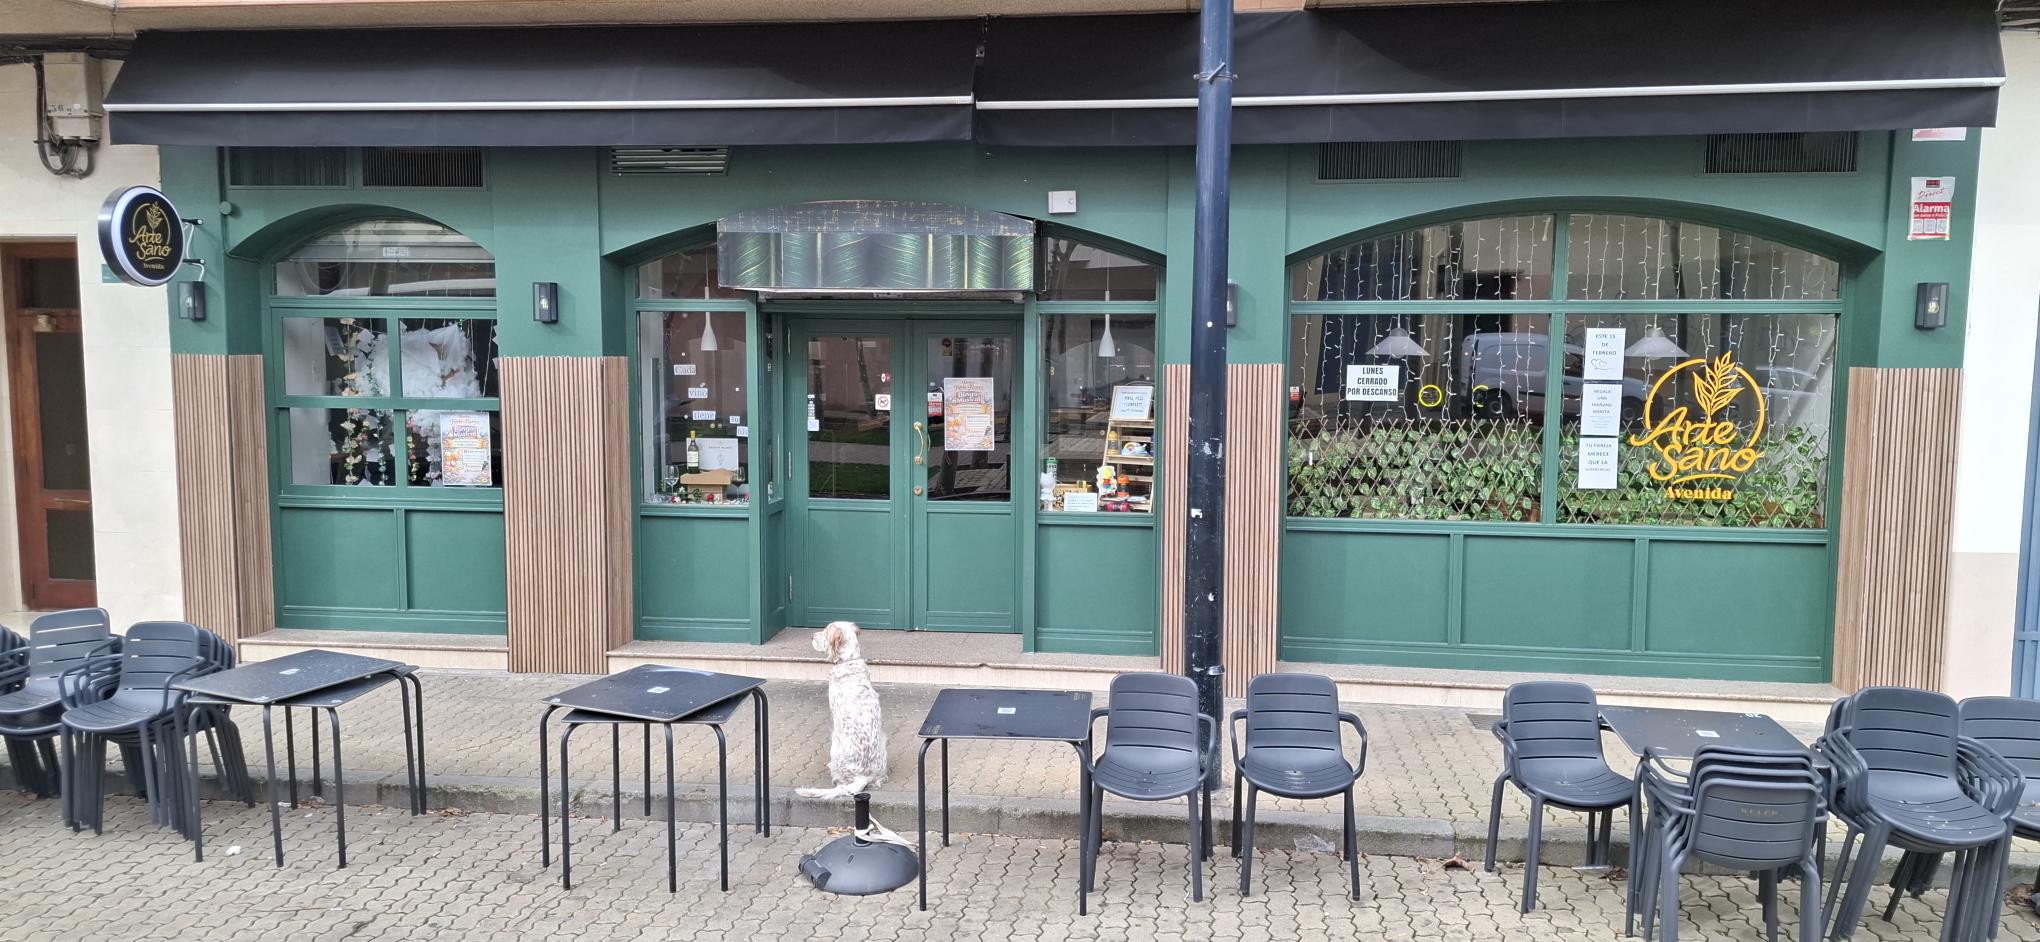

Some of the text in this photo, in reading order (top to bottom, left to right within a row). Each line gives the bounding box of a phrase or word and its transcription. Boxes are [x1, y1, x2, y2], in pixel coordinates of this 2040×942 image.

[1914, 204, 1949, 213] Alarma
[129, 225, 162, 243] Arte
[136, 242, 172, 260] Sano
[688, 389, 707, 397] vino
[1362, 388, 1397, 396] DESCANSO
[1630, 407, 1738, 446] Arte
[1650, 444, 1765, 481] Sano
[1666, 486, 1732, 500] Avenida
